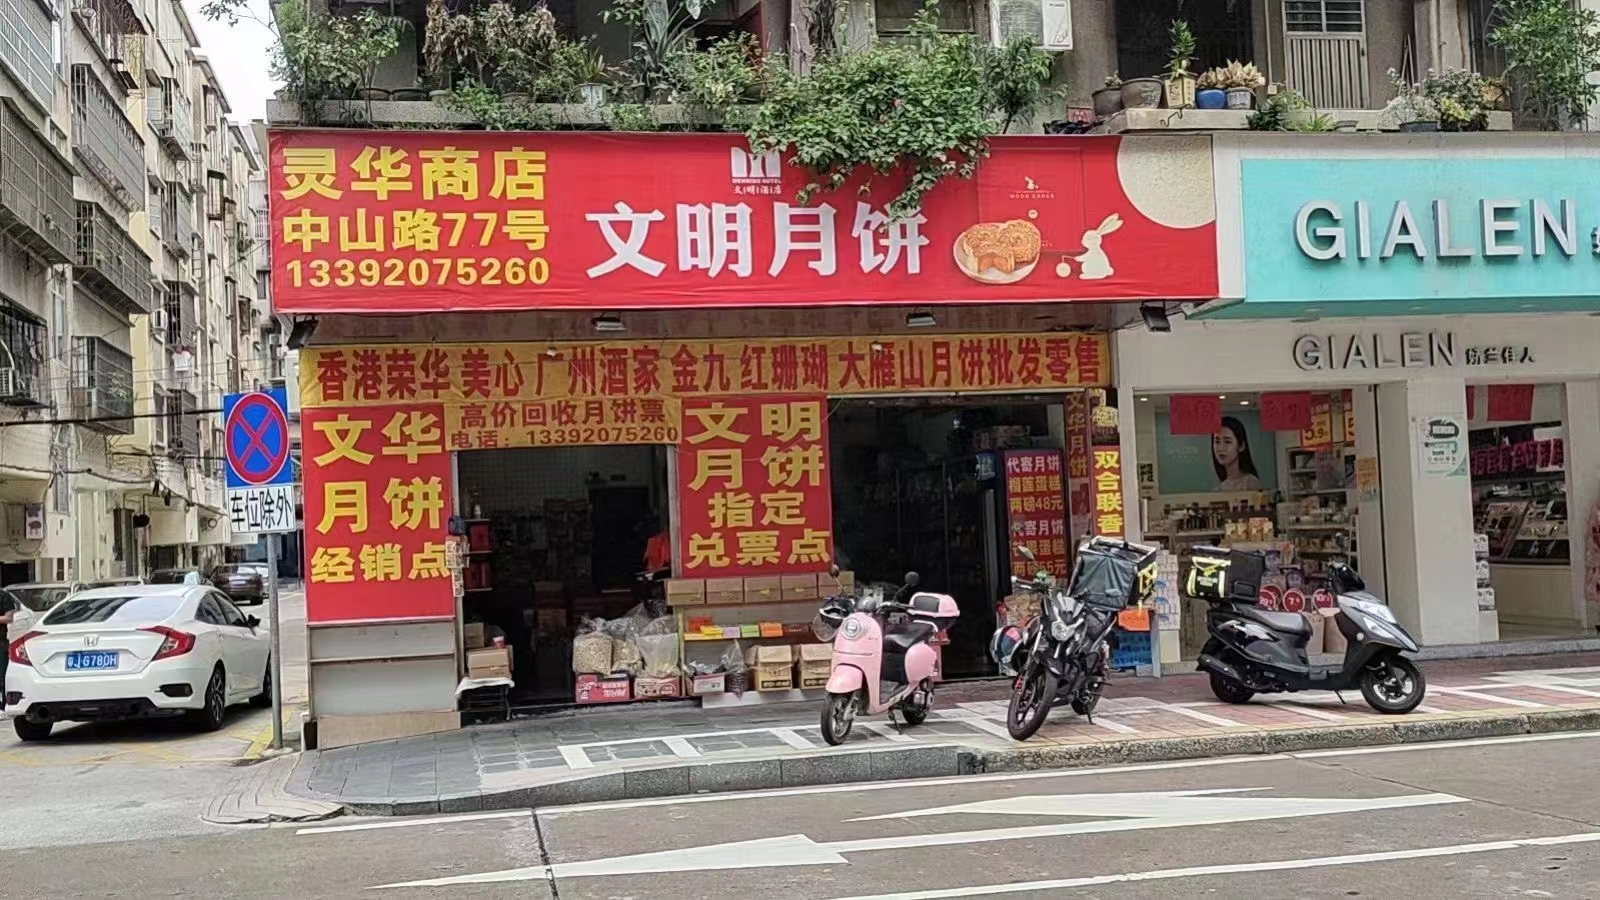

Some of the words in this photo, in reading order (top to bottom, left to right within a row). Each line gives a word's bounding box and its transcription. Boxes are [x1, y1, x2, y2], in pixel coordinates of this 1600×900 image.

[281, 146, 547, 201] 灵华商店
[282, 208, 549, 253] 中山路77号
[585, 200, 931, 279] 文明月饼
[1294, 198, 1577, 261] GIALEN
[286, 257, 550, 287] 13392075260
[317, 350, 451, 402] 香港荣华
[460, 350, 524, 399] 美心
[535, 345, 659, 397] 广州酒家
[671, 345, 731, 393] 金九
[740, 343, 829, 391] 红珊瑚
[839, 338, 1099, 389] 大雁山月饼批发零售
[1293, 332, 1457, 371] GIALEN
[459, 401, 666, 428] 高价回收月饼票
[685, 400, 822, 445] 文明
[312, 411, 443, 467] 文华
[687, 446, 825, 491] 月饼
[1007, 455, 1061, 473] 代寄月饼
[230, 488, 292, 531] 车位除外
[315, 475, 445, 535] 月饼
[707, 488, 806, 530] 指定
[1094, 450, 1123, 535] 双合联香
[310, 541, 448, 583] 经销点
[687, 527, 831, 569] 兑票点
